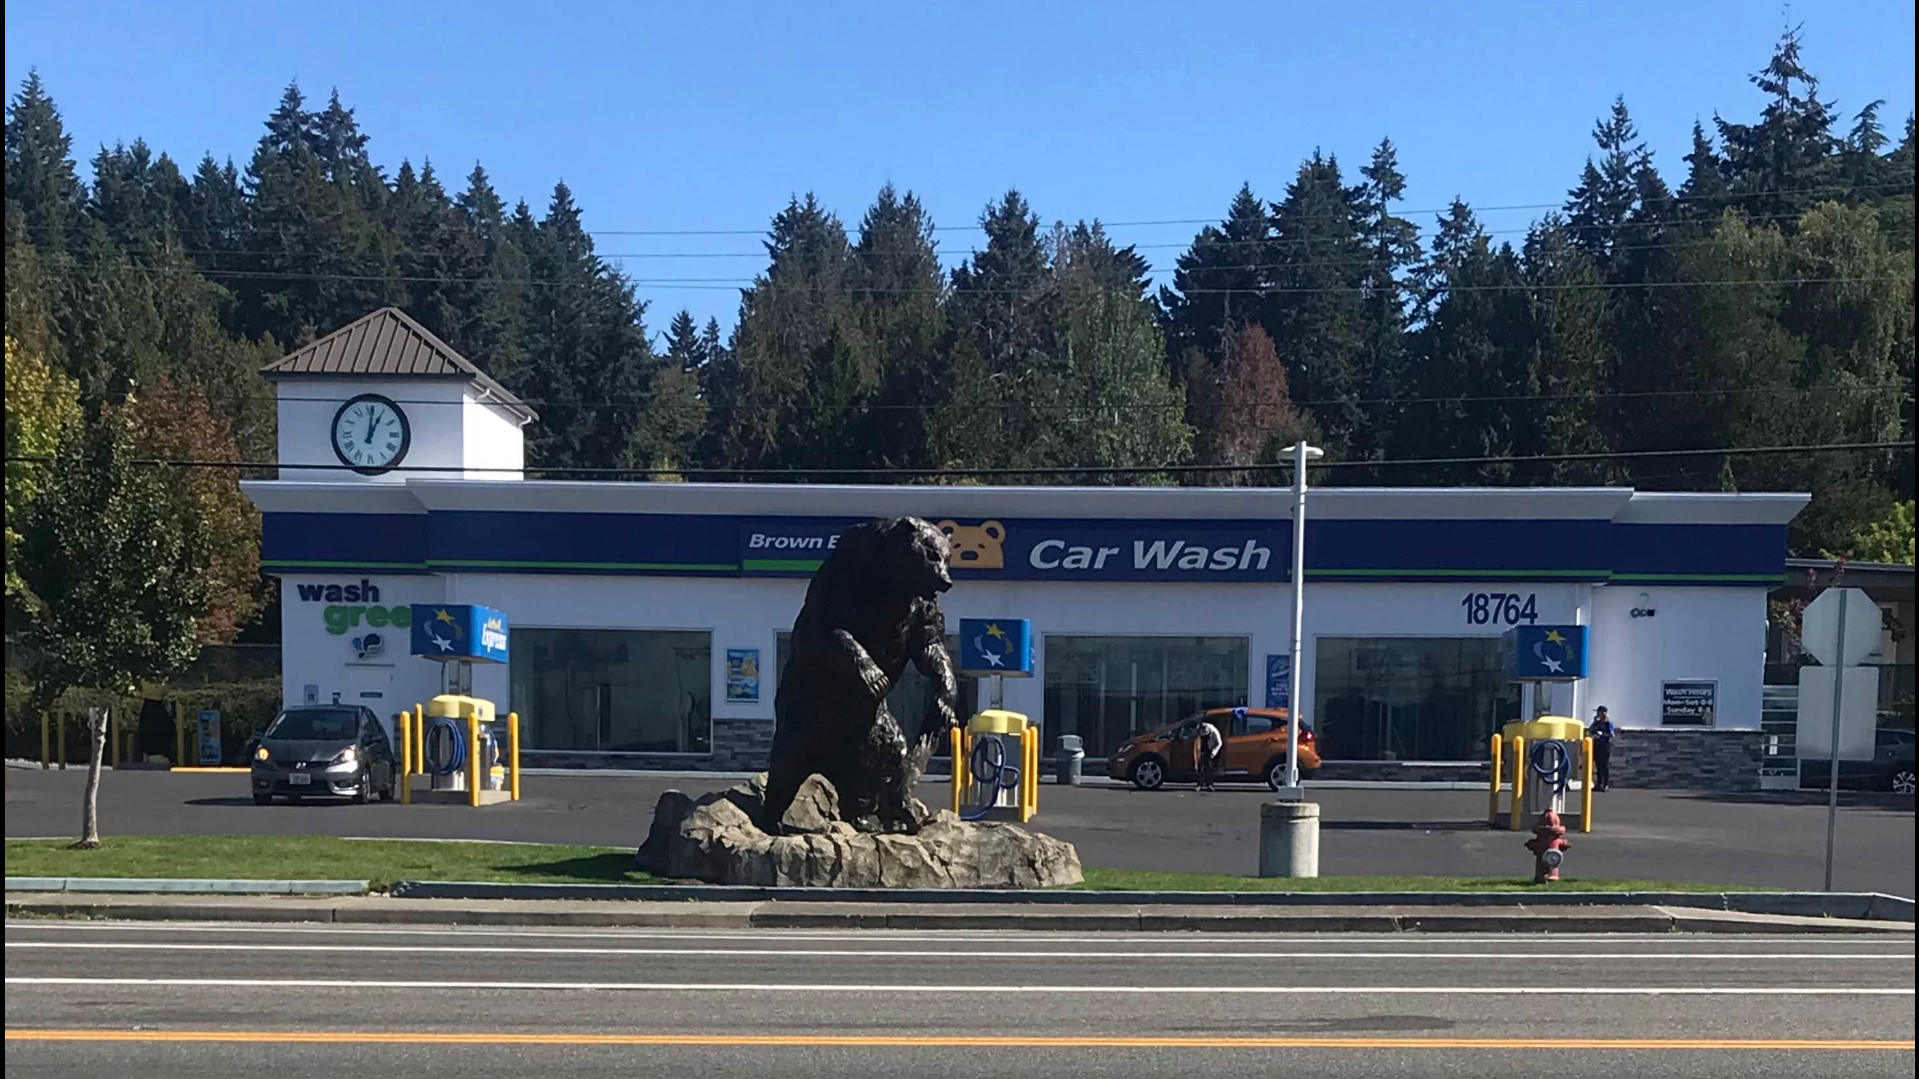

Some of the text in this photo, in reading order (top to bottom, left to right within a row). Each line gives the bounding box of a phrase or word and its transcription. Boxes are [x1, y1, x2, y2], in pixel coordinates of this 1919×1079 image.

[749, 533, 823, 549] Brown
[1029, 539, 1271, 570] Car Wash
[297, 579, 380, 602] wash
[324, 605, 411, 635] gree
[1462, 593, 1538, 625] 18764
